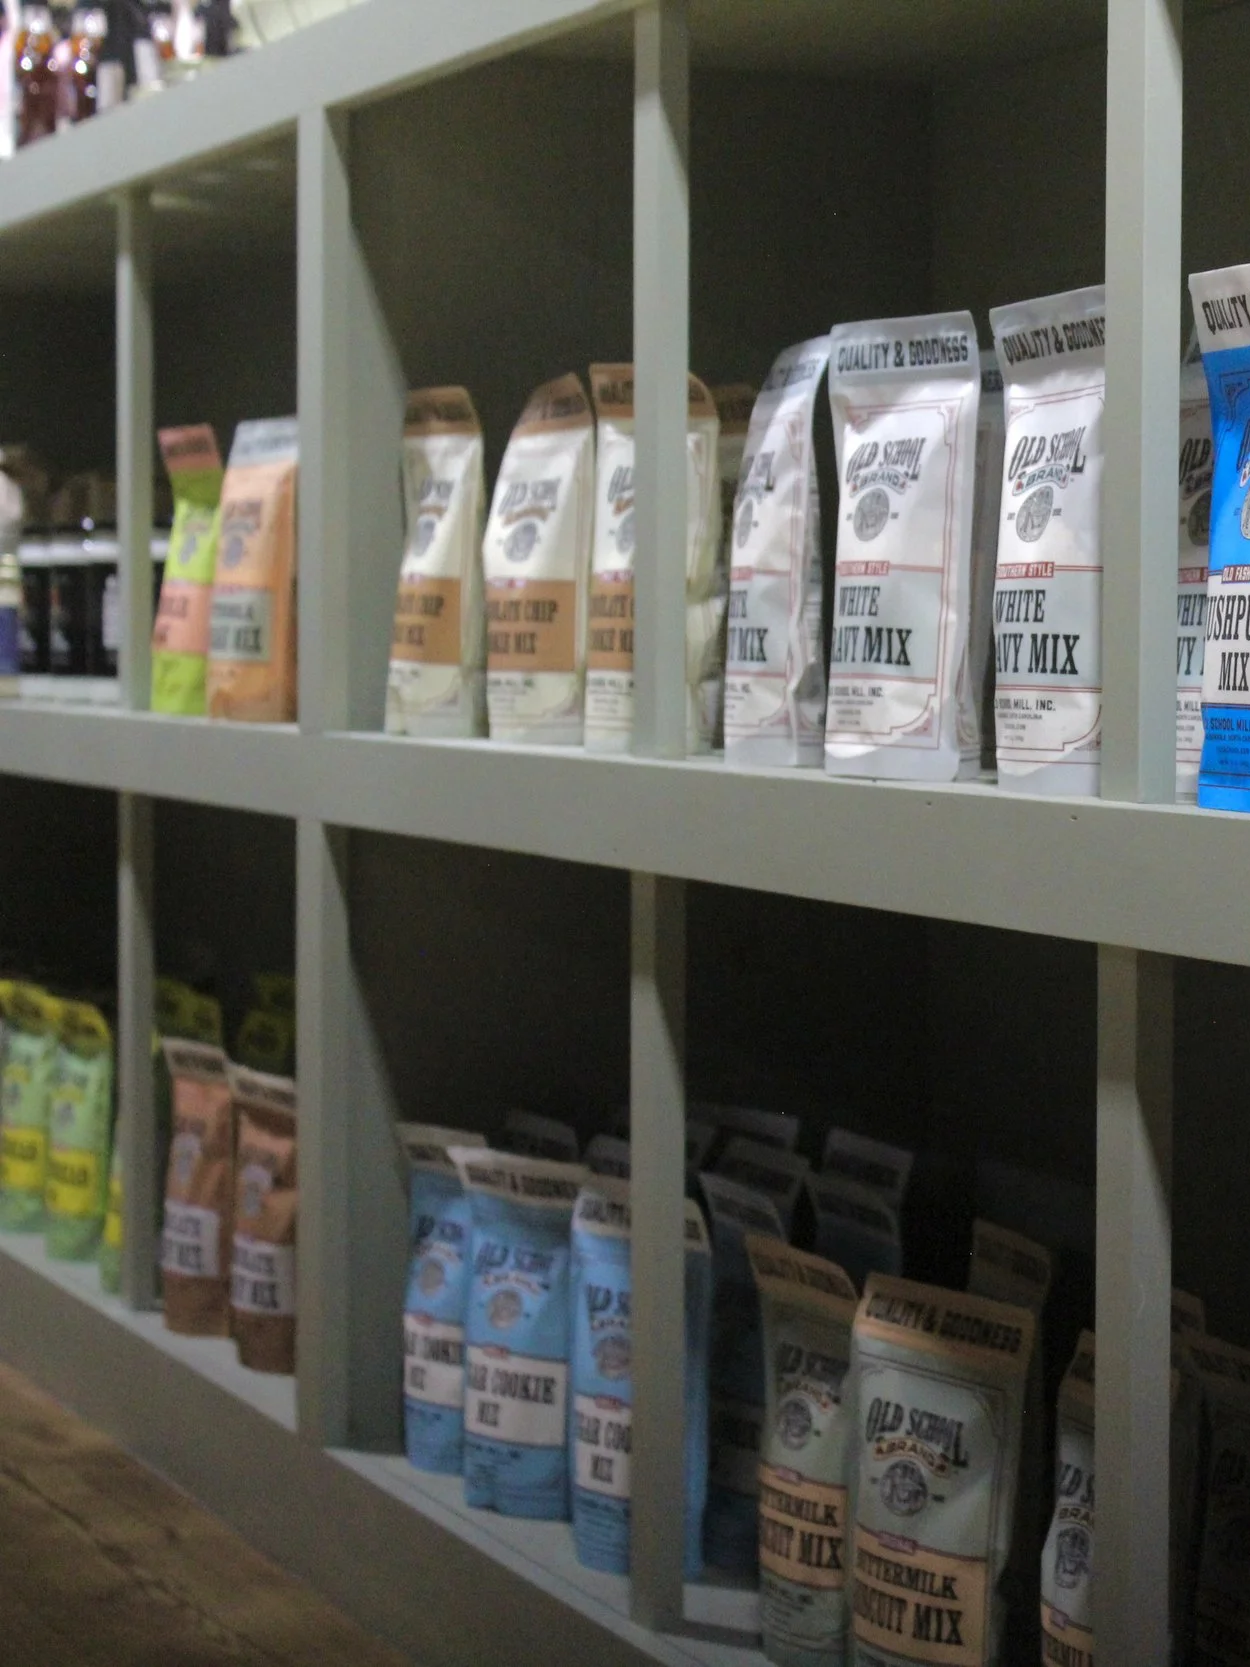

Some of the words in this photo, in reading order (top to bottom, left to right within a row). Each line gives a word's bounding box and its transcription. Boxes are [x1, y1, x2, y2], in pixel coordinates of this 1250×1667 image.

[837, 342, 890, 374] QUALITY
[893, 340, 905, 368] &
[908, 335, 969, 367] GOODNESS
[1001, 325, 1051, 366] QUALITY
[1050, 324, 1065, 354] &
[1007, 435, 1047, 482] OLD
[1028, 561, 1053, 578] STYLE
[838, 585, 881, 617] WHITE
[861, 625, 913, 667] MIX
[1027, 632, 1080, 676] MIX
[1218, 651, 1250, 692] MIX
[1035, 699, 1056, 711] INC.
[865, 1396, 905, 1443] OLD
[796, 1531, 844, 1571] MIX
[911, 1601, 965, 1648] MIX
